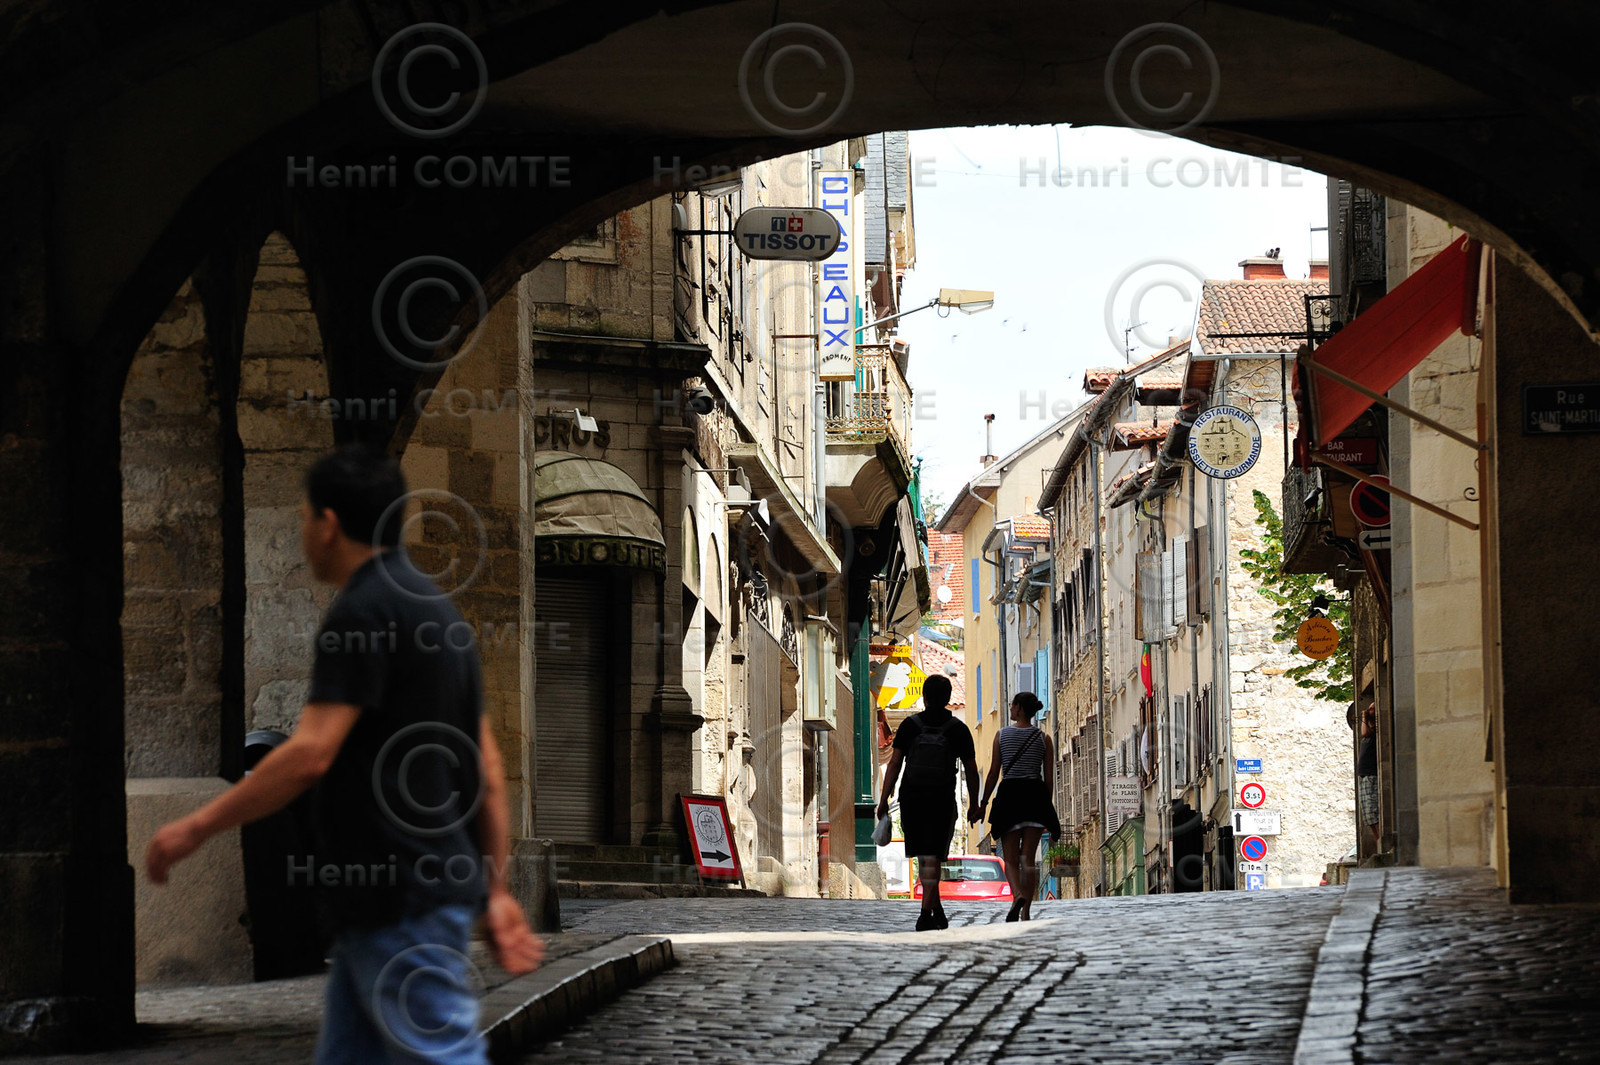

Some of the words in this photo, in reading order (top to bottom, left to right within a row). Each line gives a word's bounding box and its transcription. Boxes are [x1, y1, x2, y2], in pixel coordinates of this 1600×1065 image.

[743, 233, 831, 251] TISSOT
[822, 353, 852, 363] FROMENT
[1557, 390, 1585, 405] Rue
[1194, 407, 1252, 428] RESTAURANT
[1530, 409, 1600, 425] SAINT-MARTI
[1327, 441, 1344, 451] BAR
[1189, 437, 1220, 477] L'ASSIETTE
[1223, 437, 1260, 478] GOURMANDE
[1312, 453, 1363, 464] TAURANT
